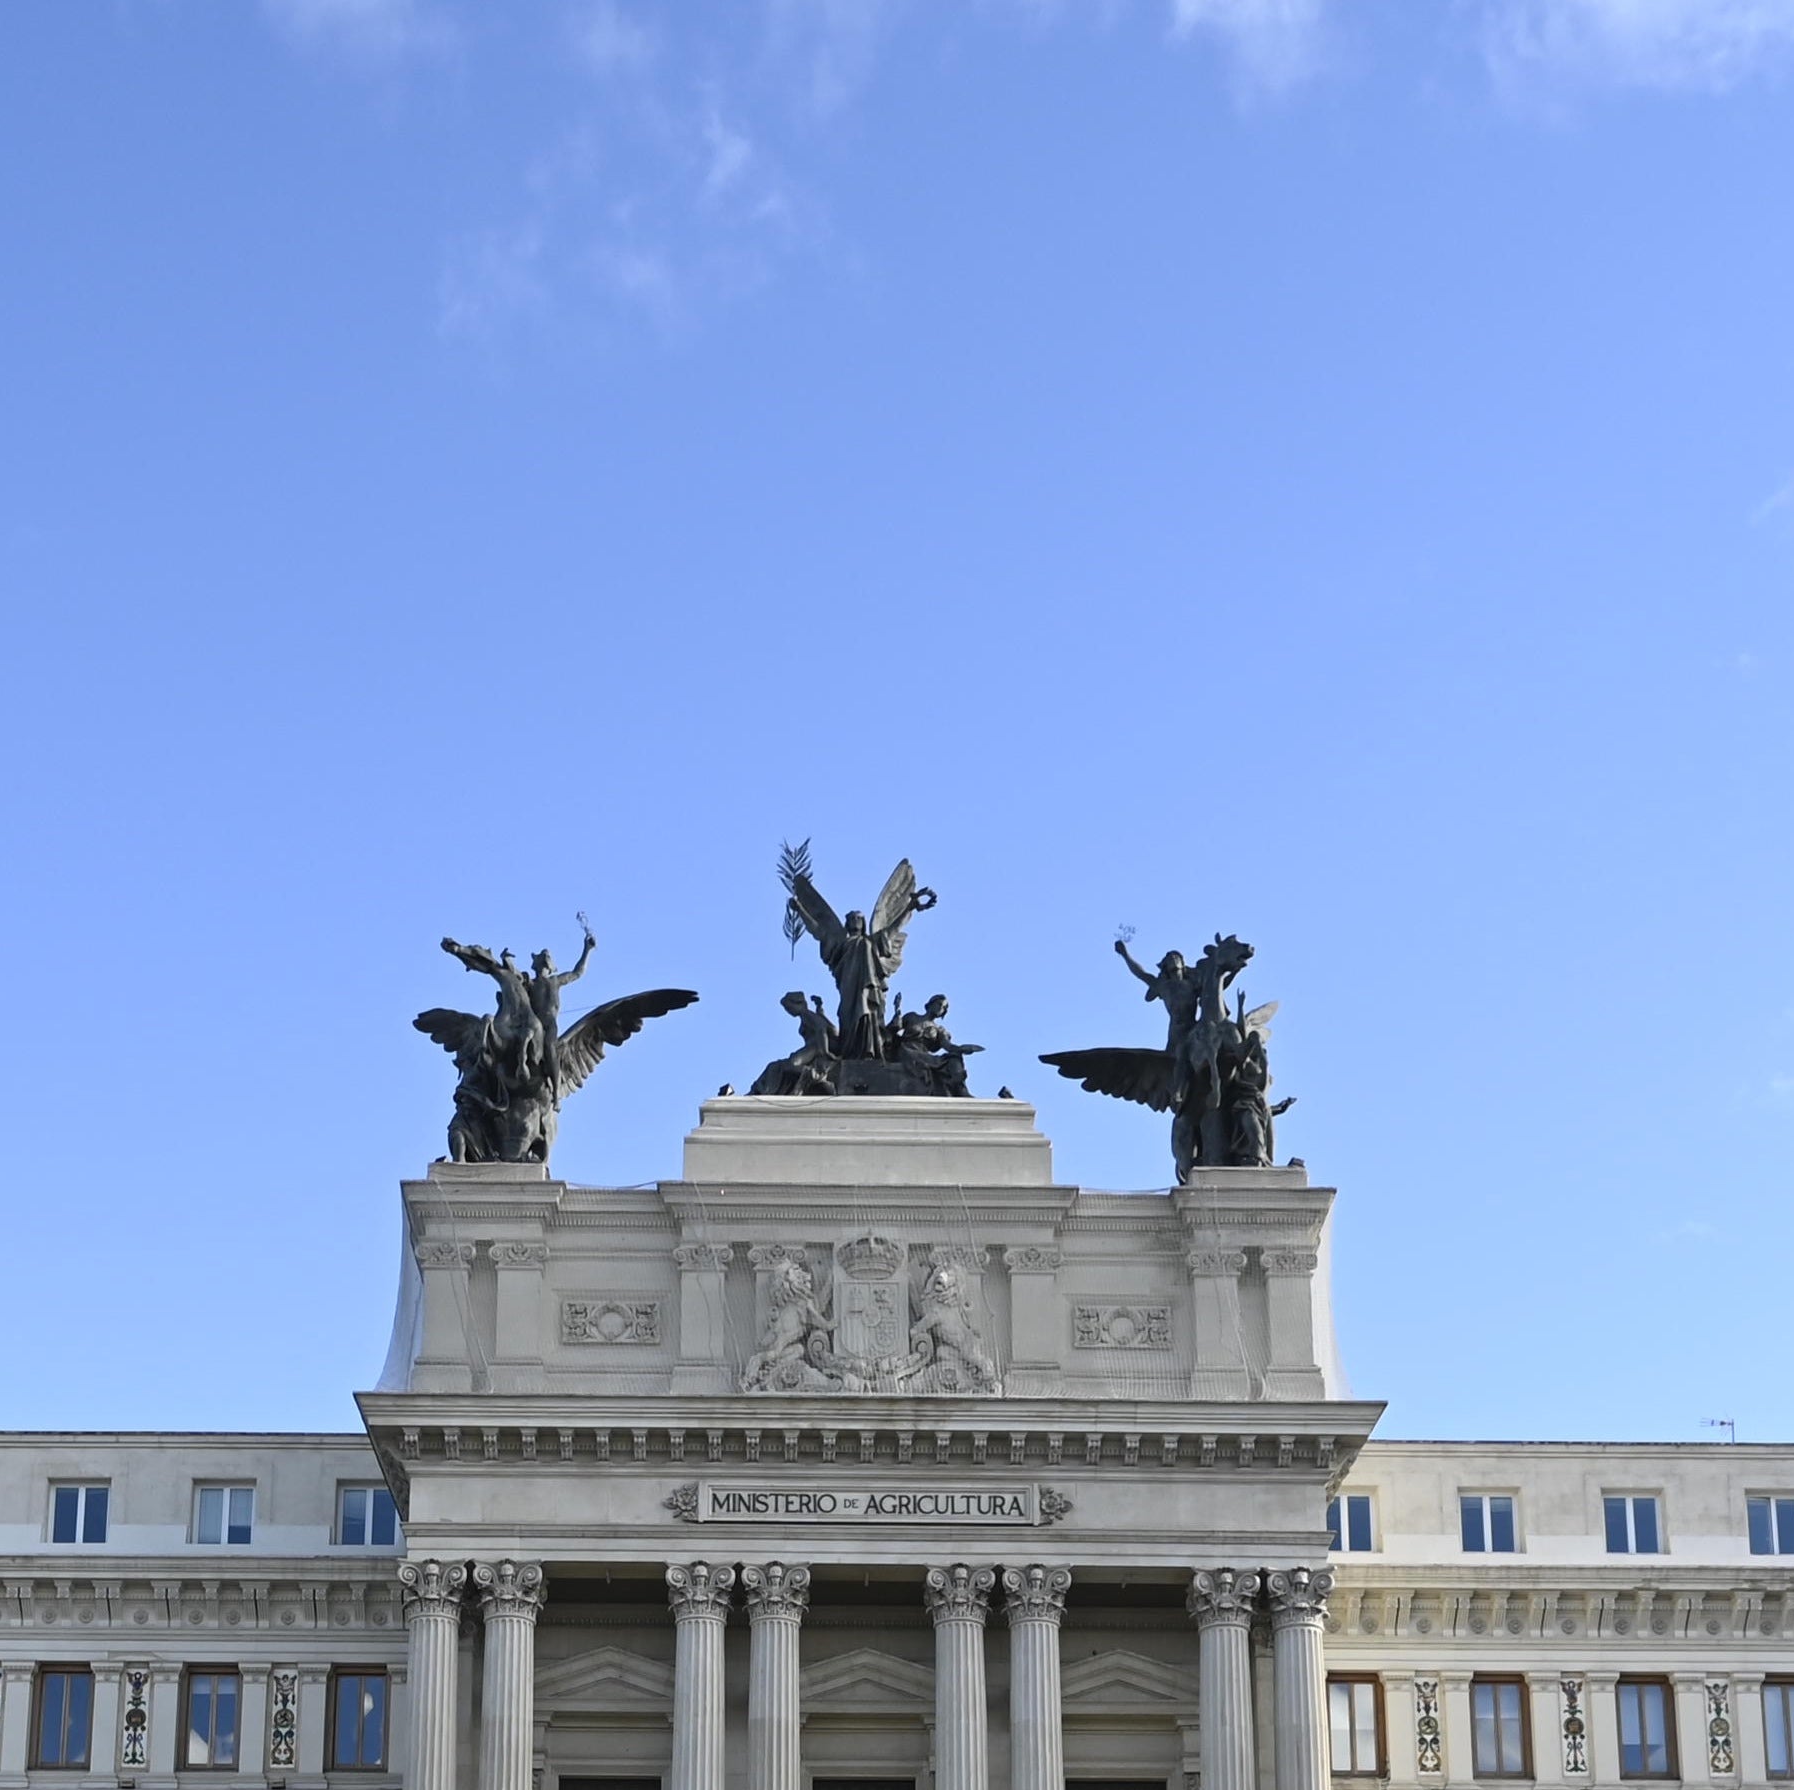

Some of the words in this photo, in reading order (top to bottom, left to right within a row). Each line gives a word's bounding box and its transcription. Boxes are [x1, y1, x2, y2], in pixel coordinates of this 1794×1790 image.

[711, 1493, 837, 1514] MINISTERIO
[843, 1498, 859, 1509] DE
[863, 1494, 1025, 1516] AGRICULTURA
